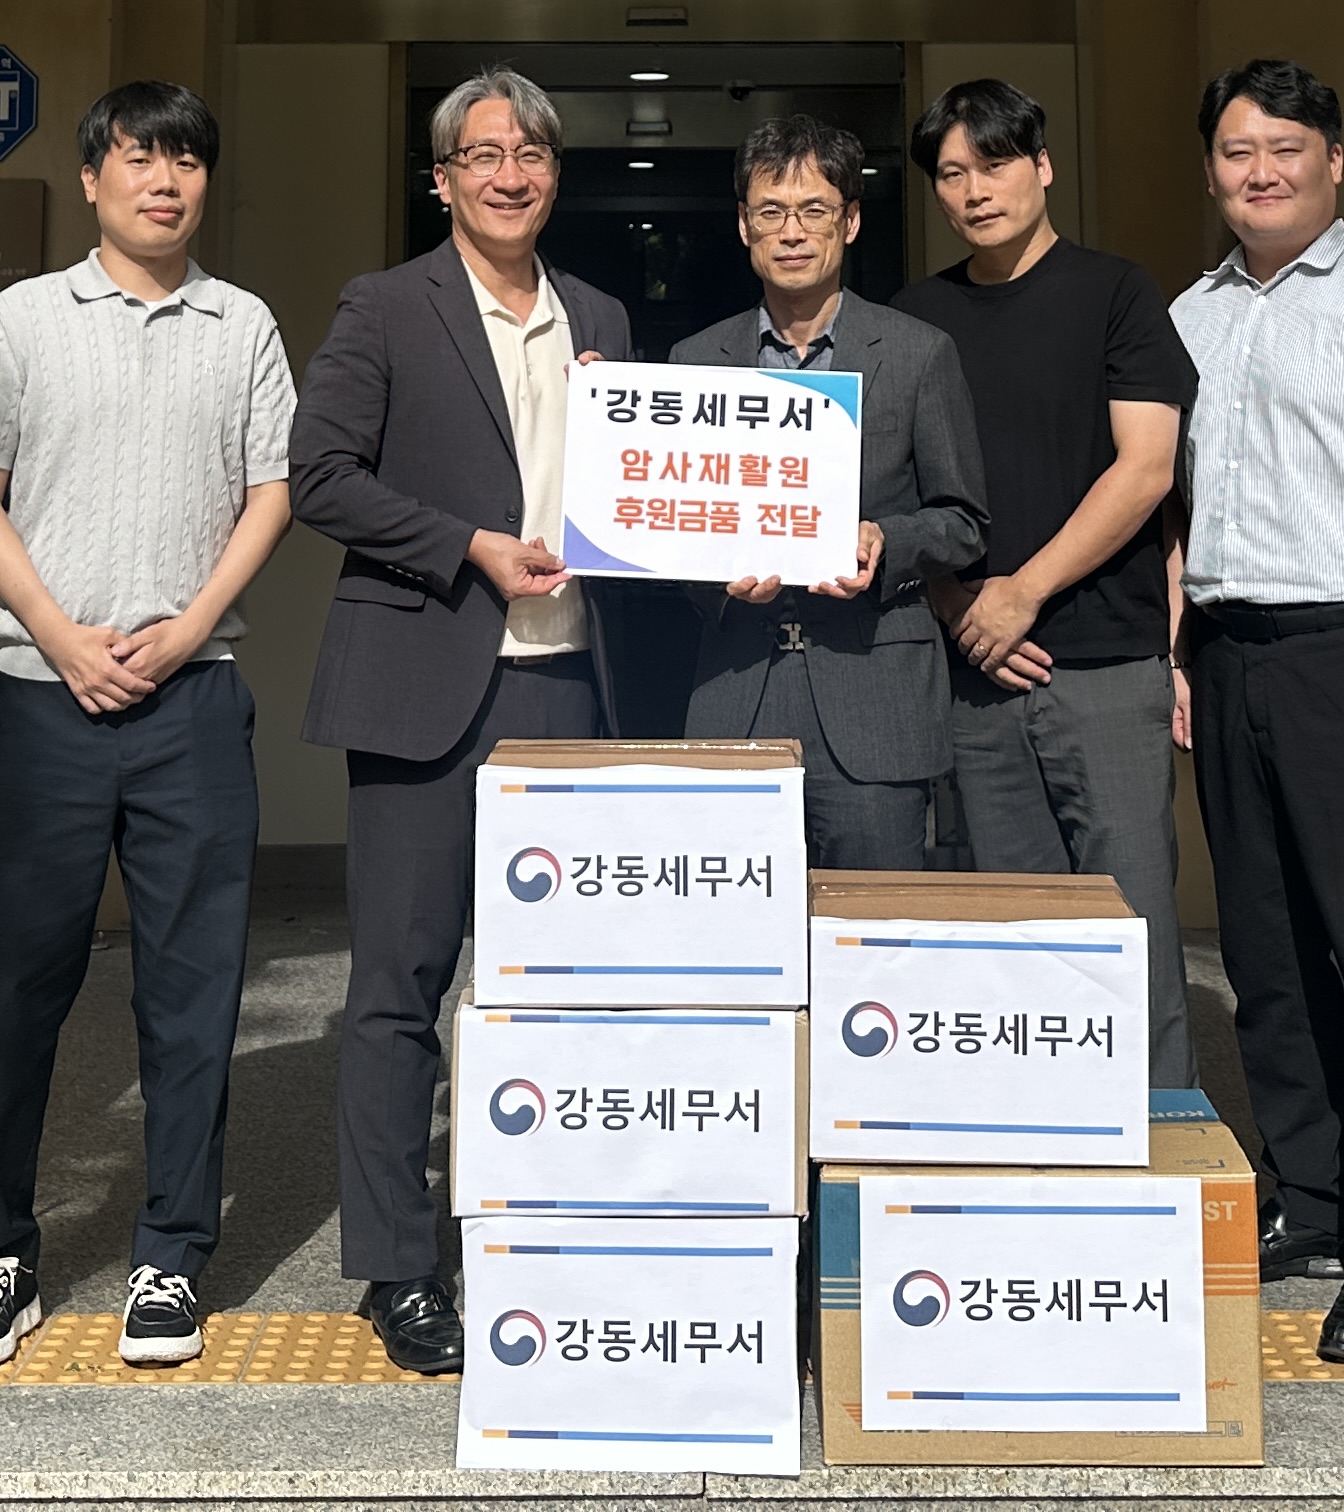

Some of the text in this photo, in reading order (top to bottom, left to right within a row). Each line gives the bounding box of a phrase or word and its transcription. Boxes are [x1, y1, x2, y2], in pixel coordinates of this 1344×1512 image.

[591, 388, 830, 431] '강동세무서'
[620, 448, 809, 489] 암사재활원
[613, 496, 822, 538] 후원금품 전달
[571, 854, 773, 899] 강동세무서
[908, 1011, 1114, 1058] 강동세무서
[555, 1087, 761, 1133] 강동세무서
[960, 1278, 1169, 1324] 강동세무서
[556, 1318, 764, 1364] 강동세무서
